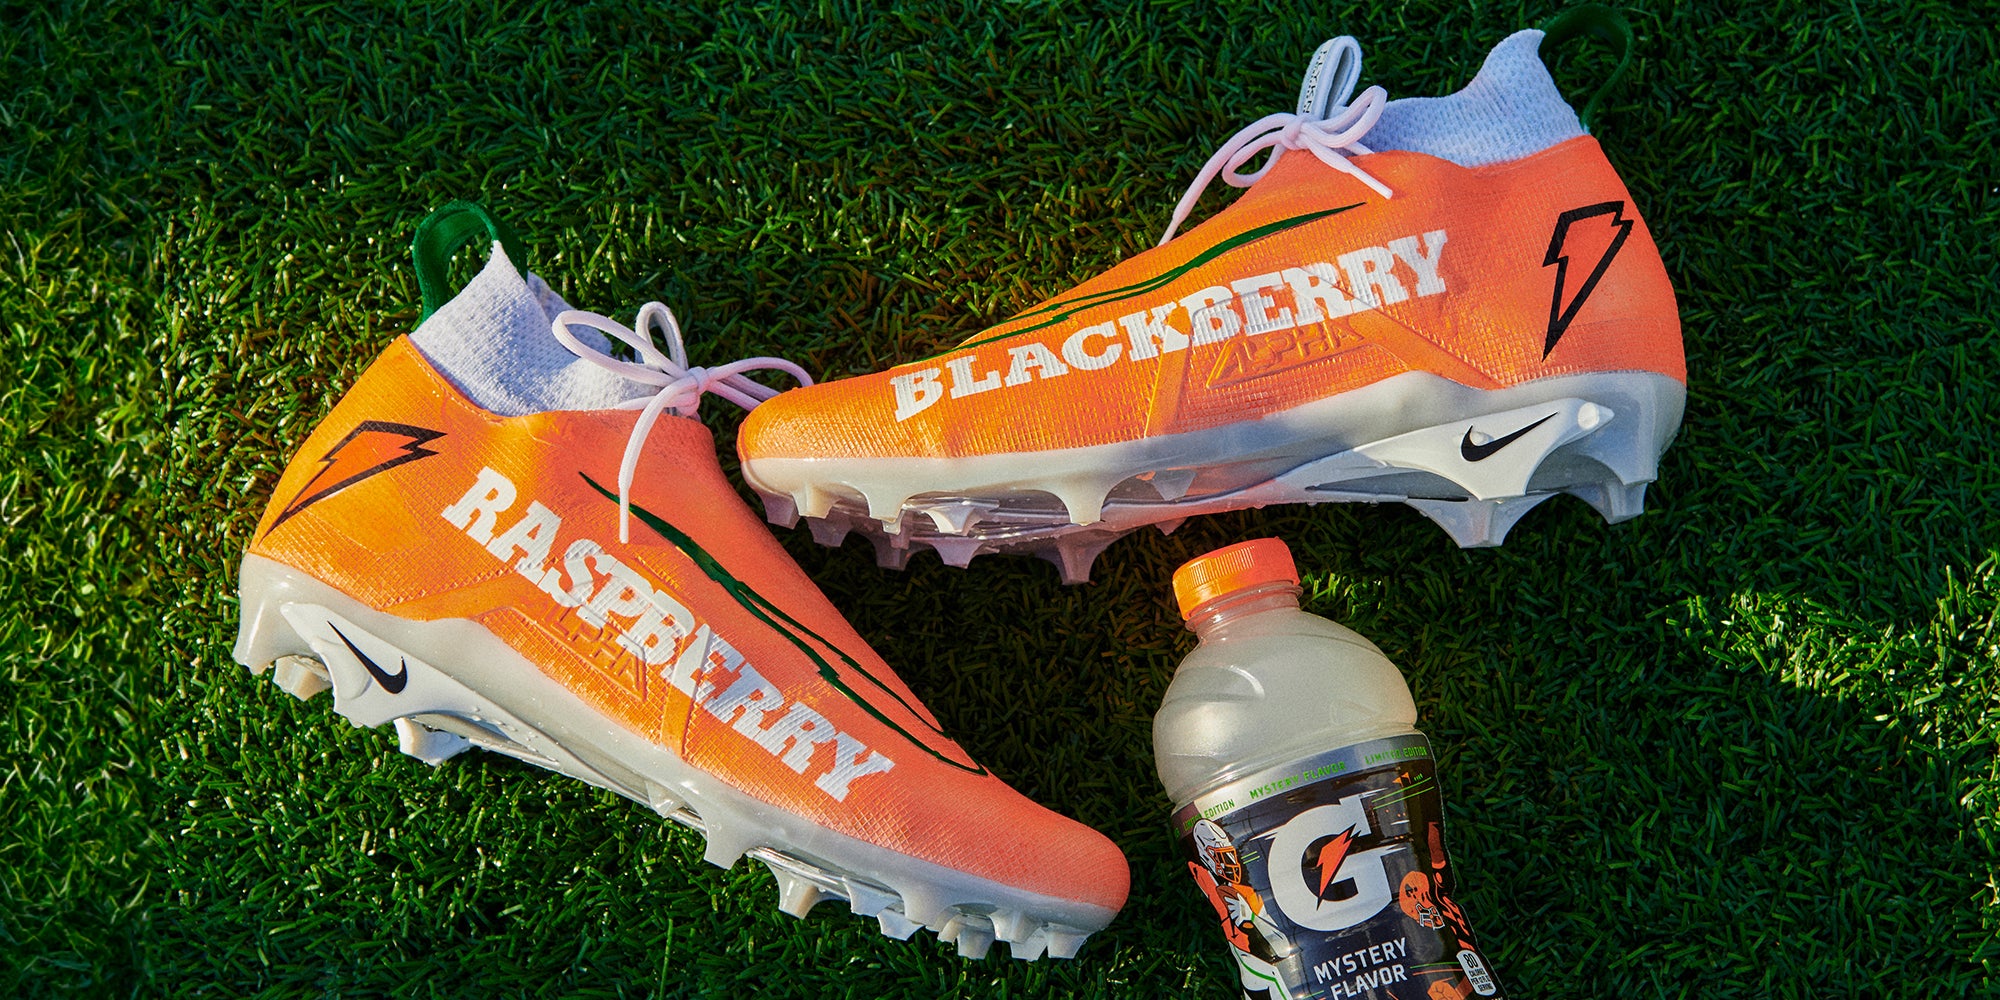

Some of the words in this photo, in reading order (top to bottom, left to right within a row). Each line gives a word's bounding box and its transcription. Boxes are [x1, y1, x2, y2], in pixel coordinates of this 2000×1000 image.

[890, 230, 1447, 422] BLACKBERRY
[1206, 317, 1365, 389] ALPHA
[441, 466, 895, 802] RASPBERRY
[526, 598, 648, 700] LPHA
[1203, 798, 1235, 819] EDITION
[1249, 775, 1299, 799] MYSTERY
[1303, 761, 1347, 781] FLAVOR
[1365, 750, 1401, 765] LIMITED
[1403, 746, 1428, 757] EDITION
[1264, 792, 1394, 931] G
[1313, 937, 1407, 984] MYSTERY
[1330, 963, 1408, 1000] FLAVOR
[1462, 953, 1479, 968] 80
